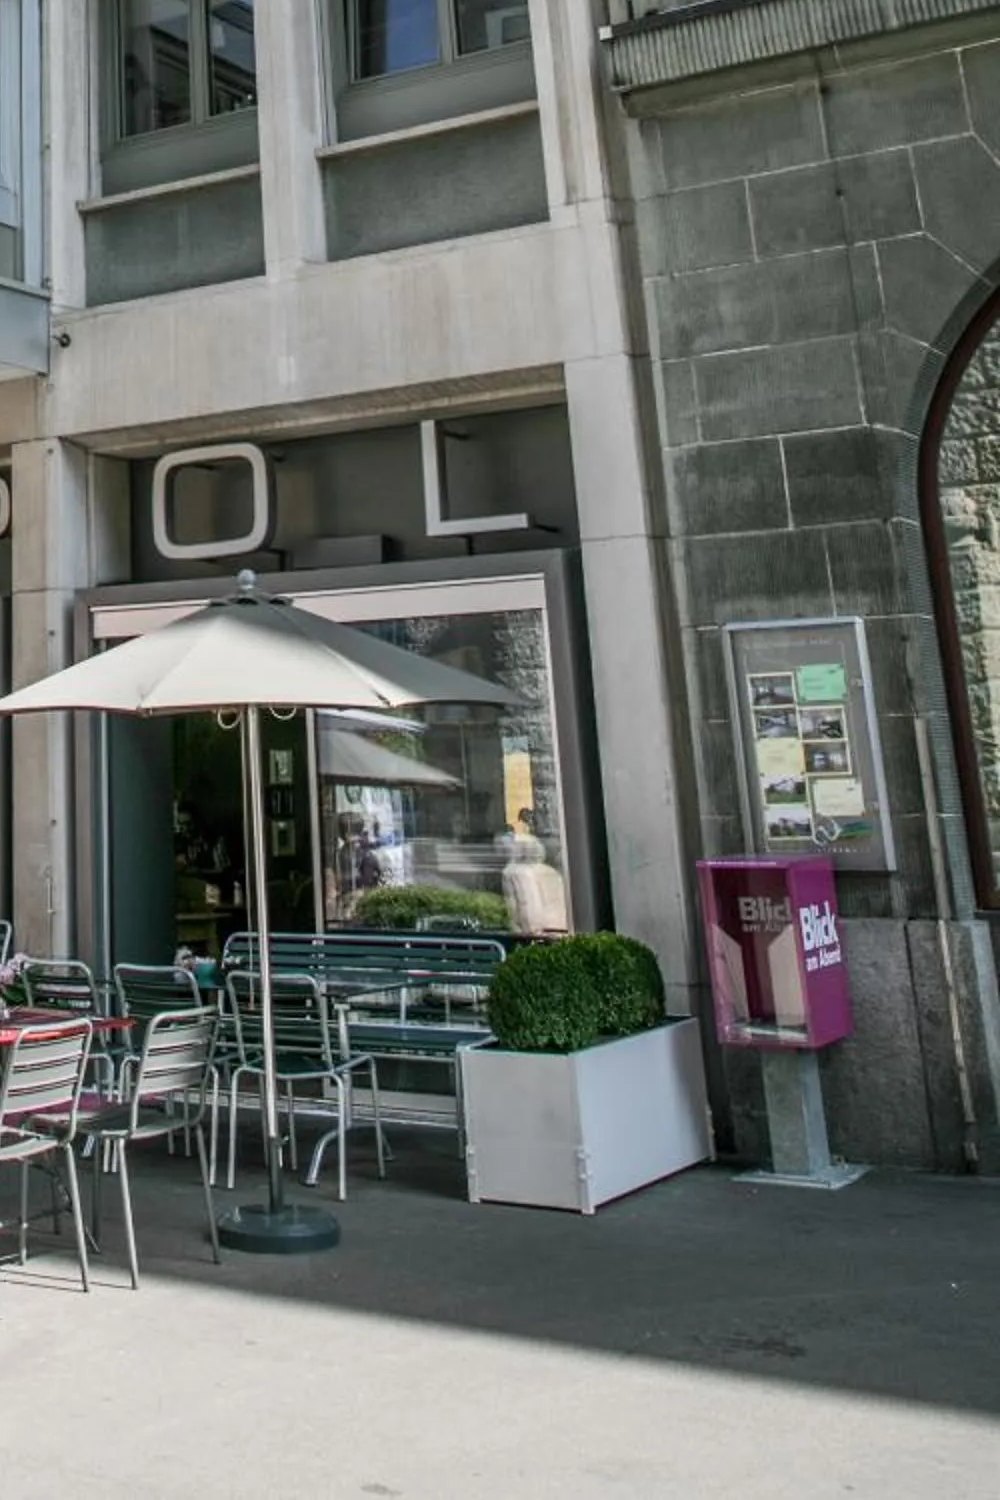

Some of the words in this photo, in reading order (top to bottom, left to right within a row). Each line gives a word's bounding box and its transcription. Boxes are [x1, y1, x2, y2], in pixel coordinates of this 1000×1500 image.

[799, 900, 839, 951] Blick
[805, 956, 819, 973] am
[819, 943, 842, 969] Abend
